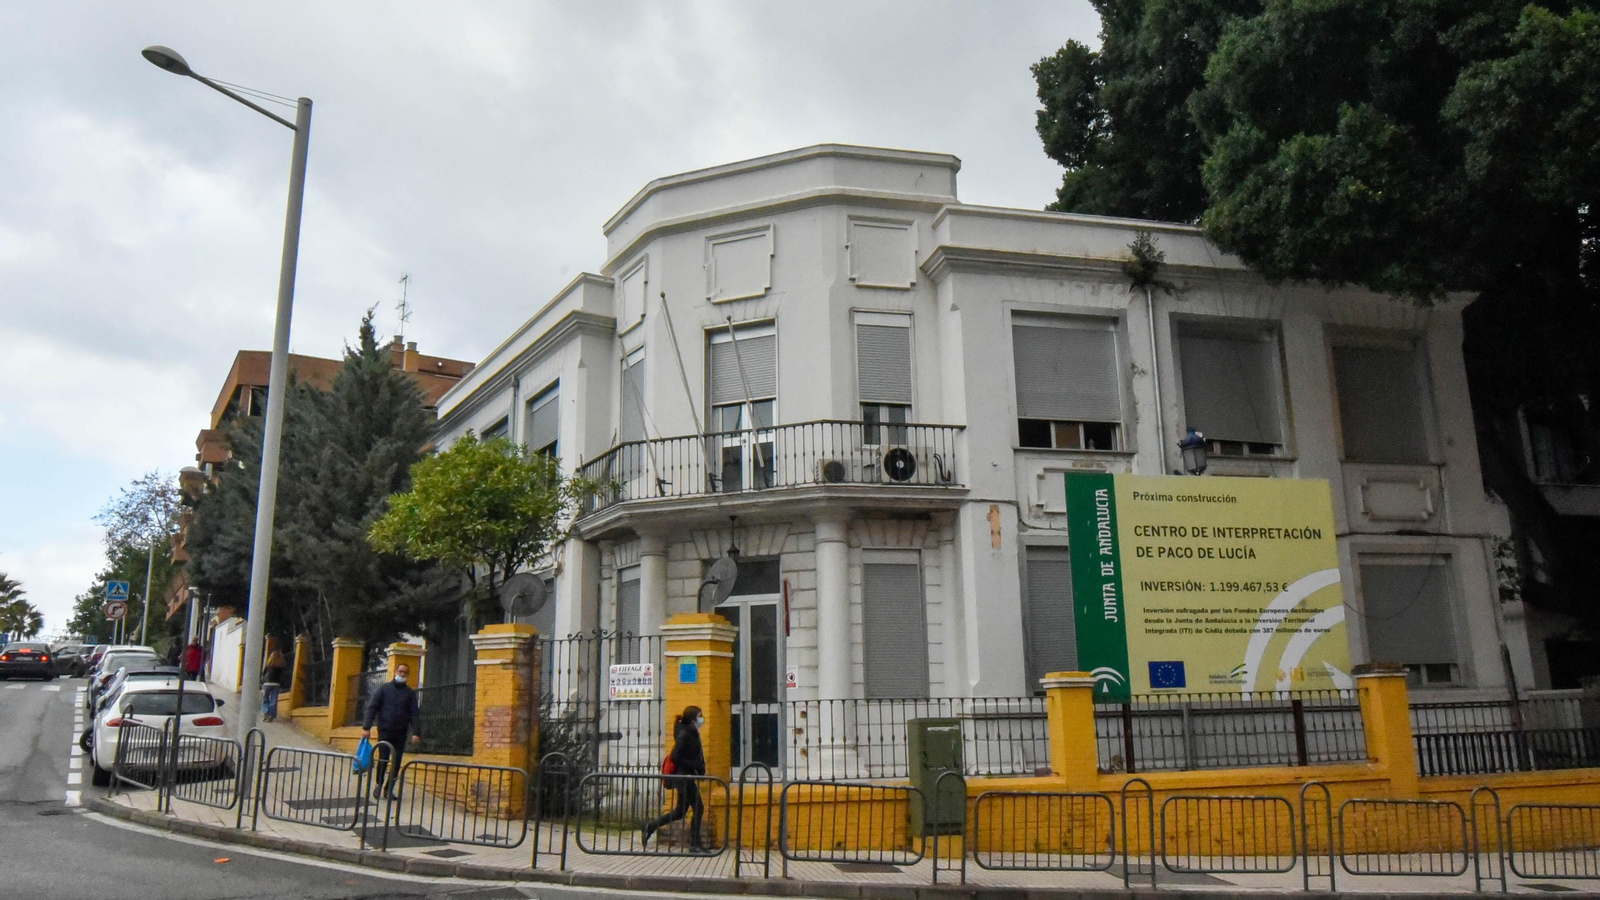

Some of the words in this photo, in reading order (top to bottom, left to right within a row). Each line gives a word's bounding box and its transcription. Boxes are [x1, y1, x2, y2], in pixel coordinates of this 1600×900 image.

[1133, 491, 1173, 502] Próxima
[1176, 494, 1237, 503] construcción
[1095, 488, 1112, 555] ANDALUCIA
[1134, 525, 1187, 538] CENTRO
[1191, 526, 1209, 538] DE
[1213, 526, 1322, 540] INTERPRETACIÓN
[1136, 546, 1154, 558] DE
[1158, 547, 1193, 558] PACO
[1198, 548, 1215, 559] DE
[1219, 545, 1257, 559] LUCÍA
[1100, 561, 1114, 577] DE
[1140, 579, 1206, 592] INVERSIÓN:
[1210, 581, 1279, 593] 1.199.467,53
[1282, 582, 1289, 592] €
[1102, 582, 1118, 623] JUNTA
[1176, 607, 1208, 616] sufragada
[1210, 608, 1221, 616] por
[1259, 607, 1290, 616] Europeos
[1145, 627, 1178, 635] Integrada
